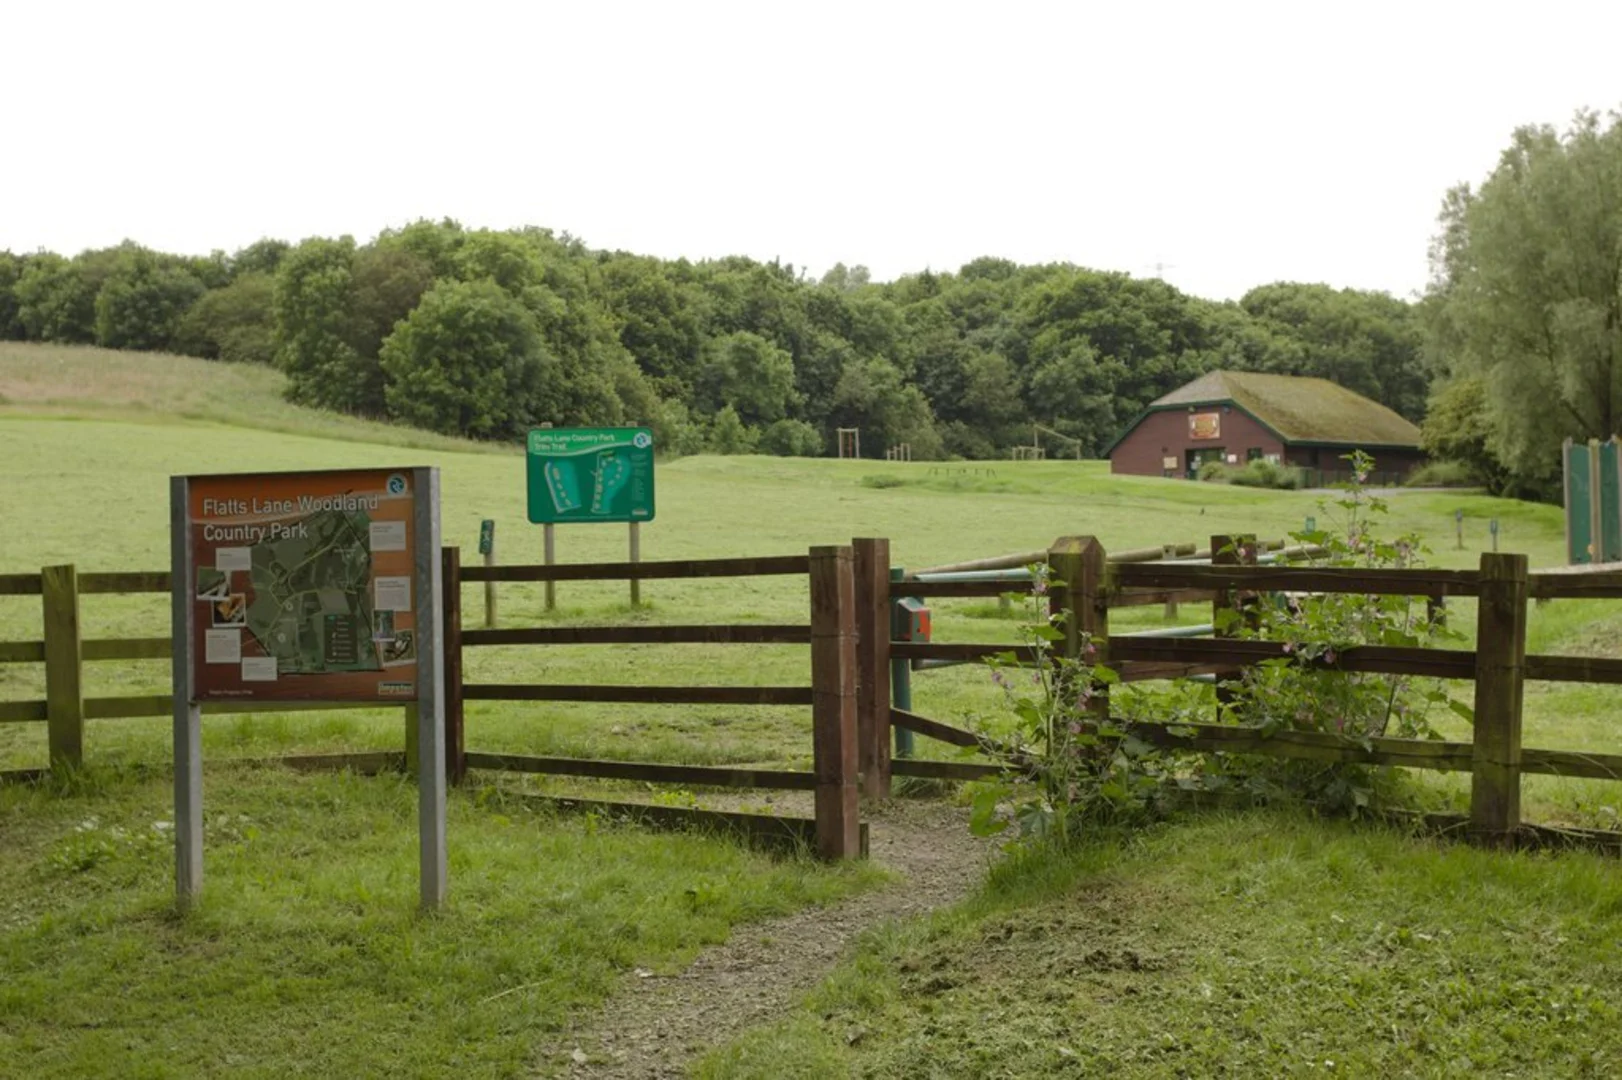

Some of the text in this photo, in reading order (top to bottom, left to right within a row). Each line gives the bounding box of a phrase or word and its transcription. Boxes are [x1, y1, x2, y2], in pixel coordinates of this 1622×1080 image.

[572, 433, 598, 443] Country
[600, 434, 614, 442] Park
[203, 494, 379, 516] Flatts Lane Woodland
[203, 523, 309, 543] Country Park
